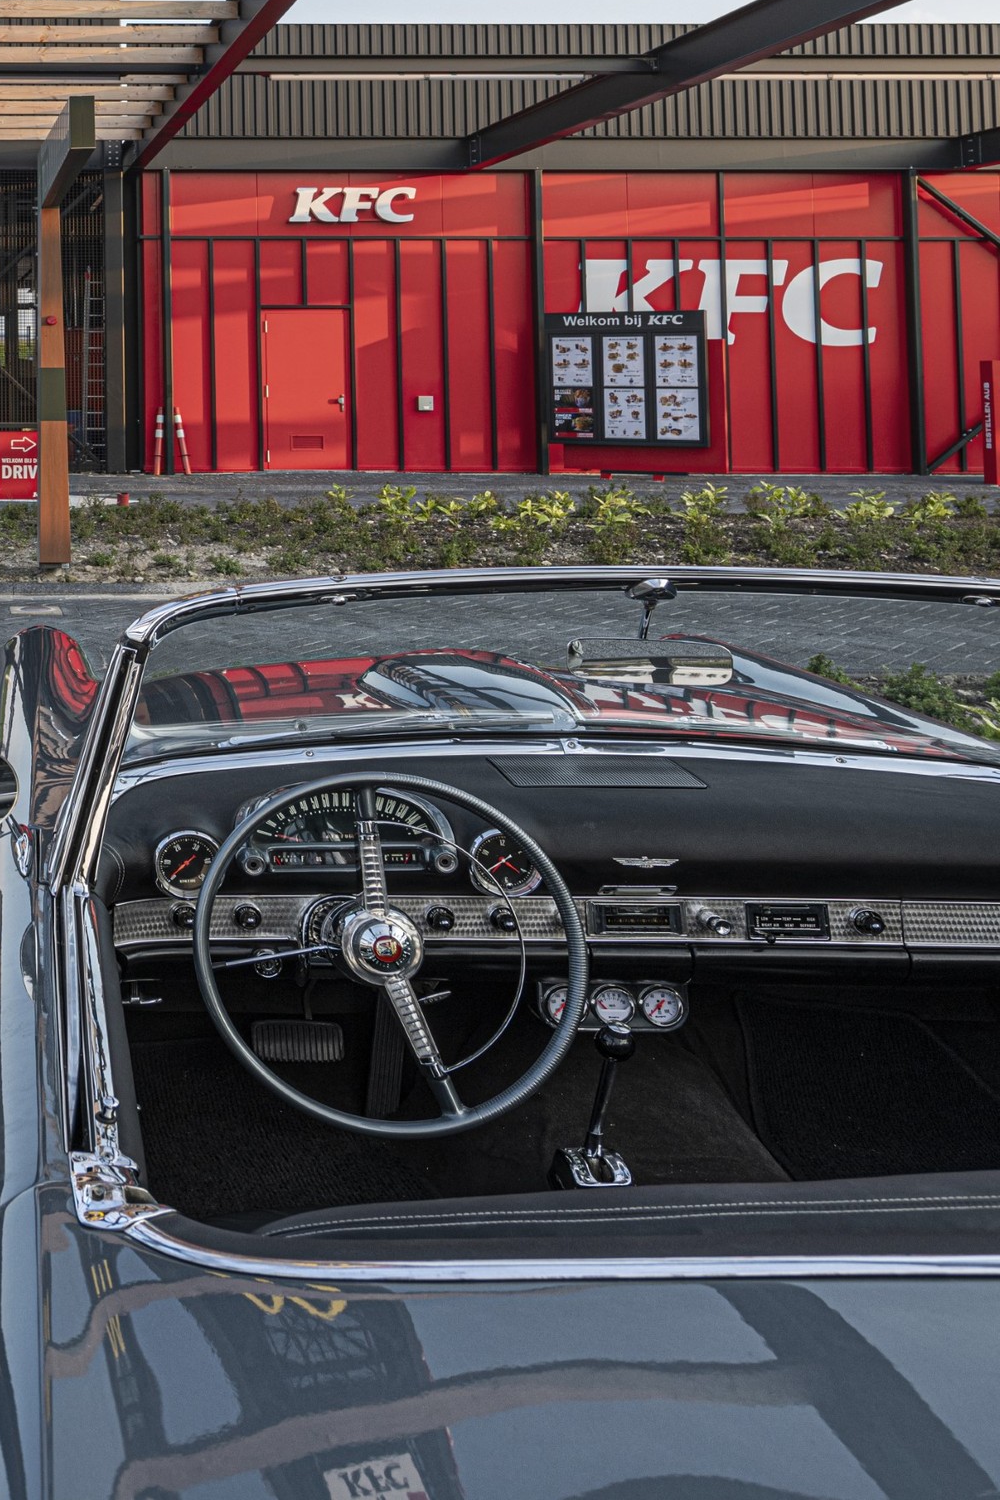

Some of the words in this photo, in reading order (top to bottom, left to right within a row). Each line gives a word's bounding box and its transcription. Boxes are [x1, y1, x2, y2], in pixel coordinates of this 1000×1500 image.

[288, 186, 417, 224] KFC
[563, 315, 620, 327] Welkom
[624, 314, 642, 328] bij
[647, 314, 684, 326] KFC
[578, 258, 884, 347] KFC
